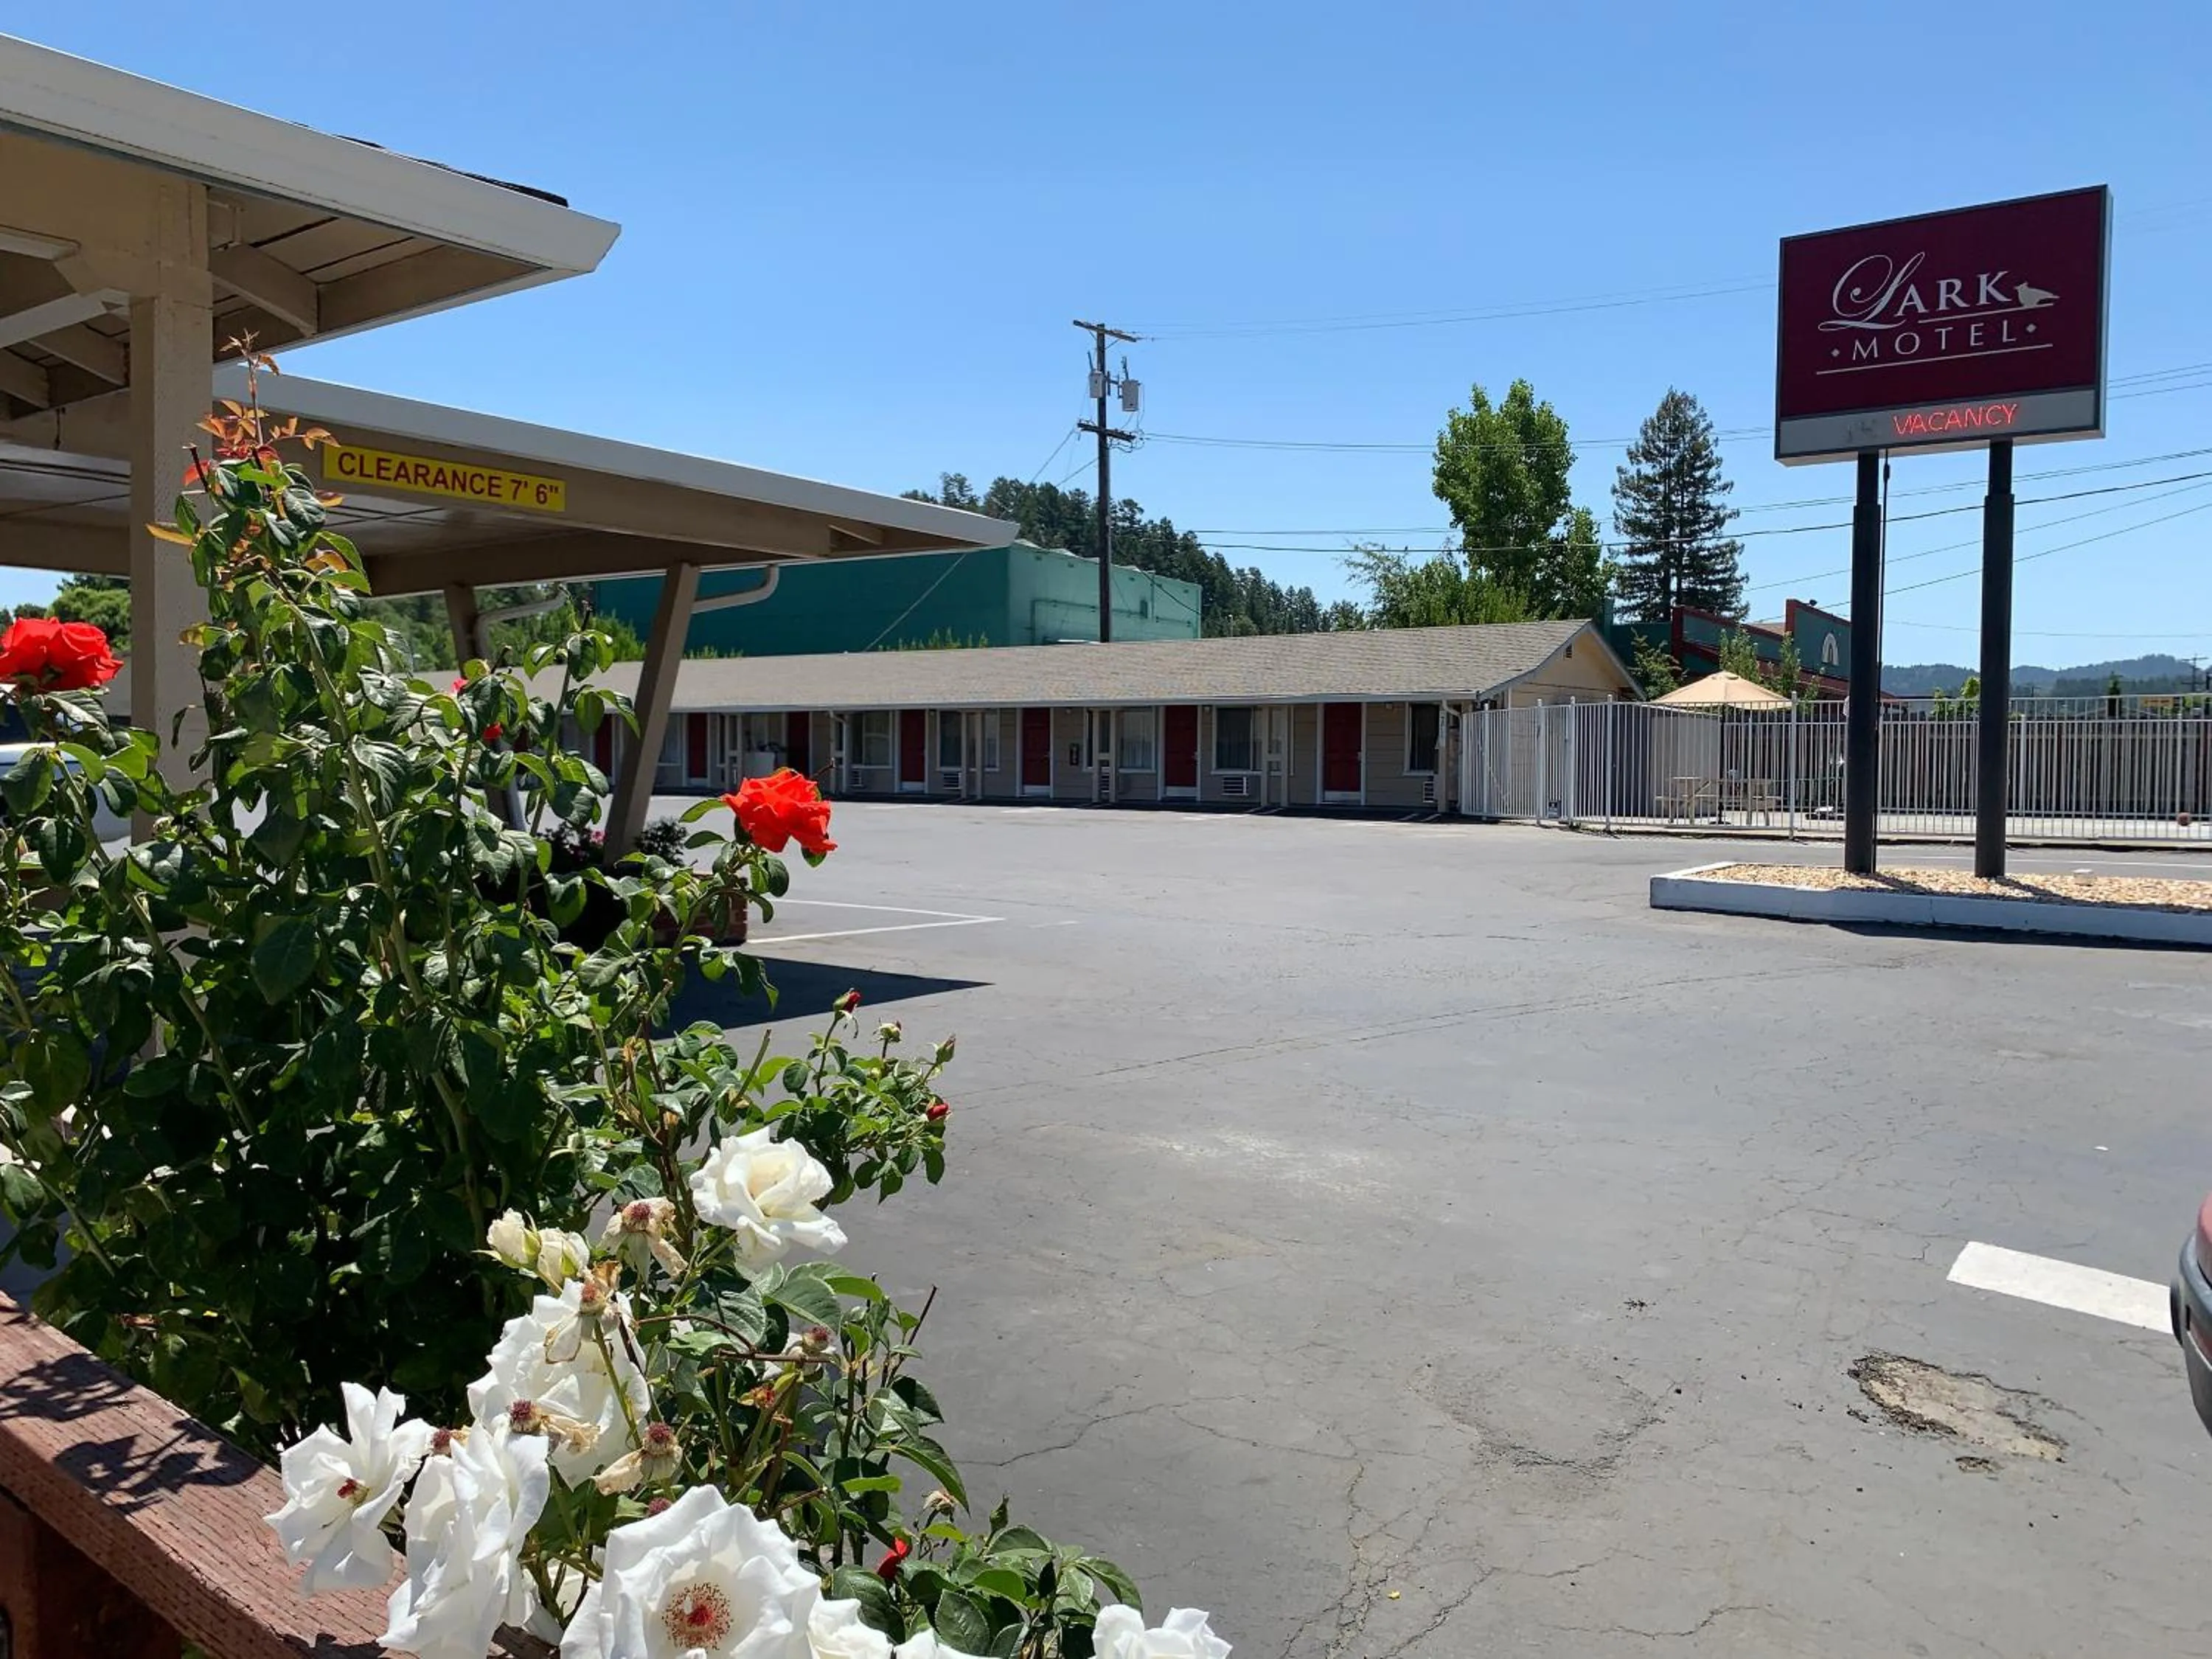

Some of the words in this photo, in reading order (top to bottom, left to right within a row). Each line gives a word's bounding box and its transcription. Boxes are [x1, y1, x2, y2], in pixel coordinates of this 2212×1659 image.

[1818, 252, 2012, 331] LARK
[1852, 320, 2017, 361] MOTEL
[1893, 403, 2017, 434] VACANCY
[338, 452, 502, 498] CLEARANCE
